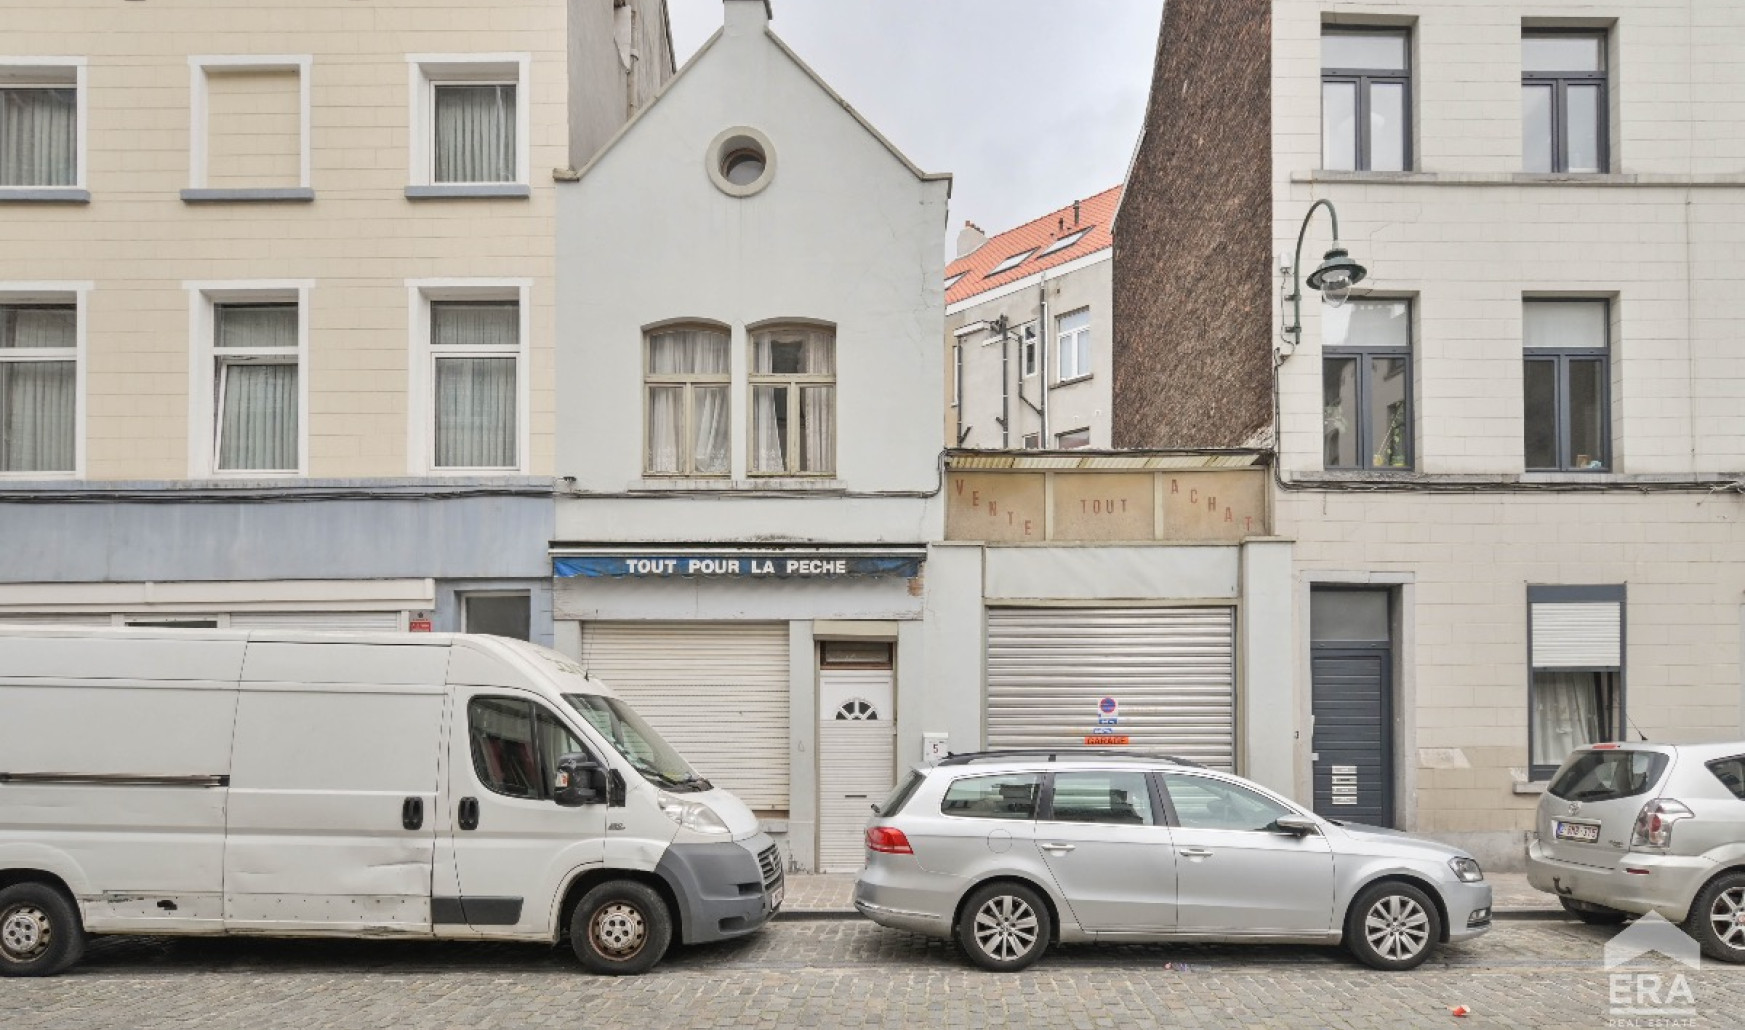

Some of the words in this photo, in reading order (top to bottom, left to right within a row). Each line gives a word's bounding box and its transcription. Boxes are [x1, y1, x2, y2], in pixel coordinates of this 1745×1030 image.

[955, 479, 1032, 536] VENTE
[1080, 499, 1128, 514] TOUT
[1171, 479, 1252, 532] ACHAT
[626, 559, 677, 575] TOUT
[688, 559, 740, 575] POUR
[751, 559, 776, 575] LA
[786, 559, 846, 575] PECHE
[1087, 736, 1127, 745] GARAGE
[932, 743, 939, 754] 5
